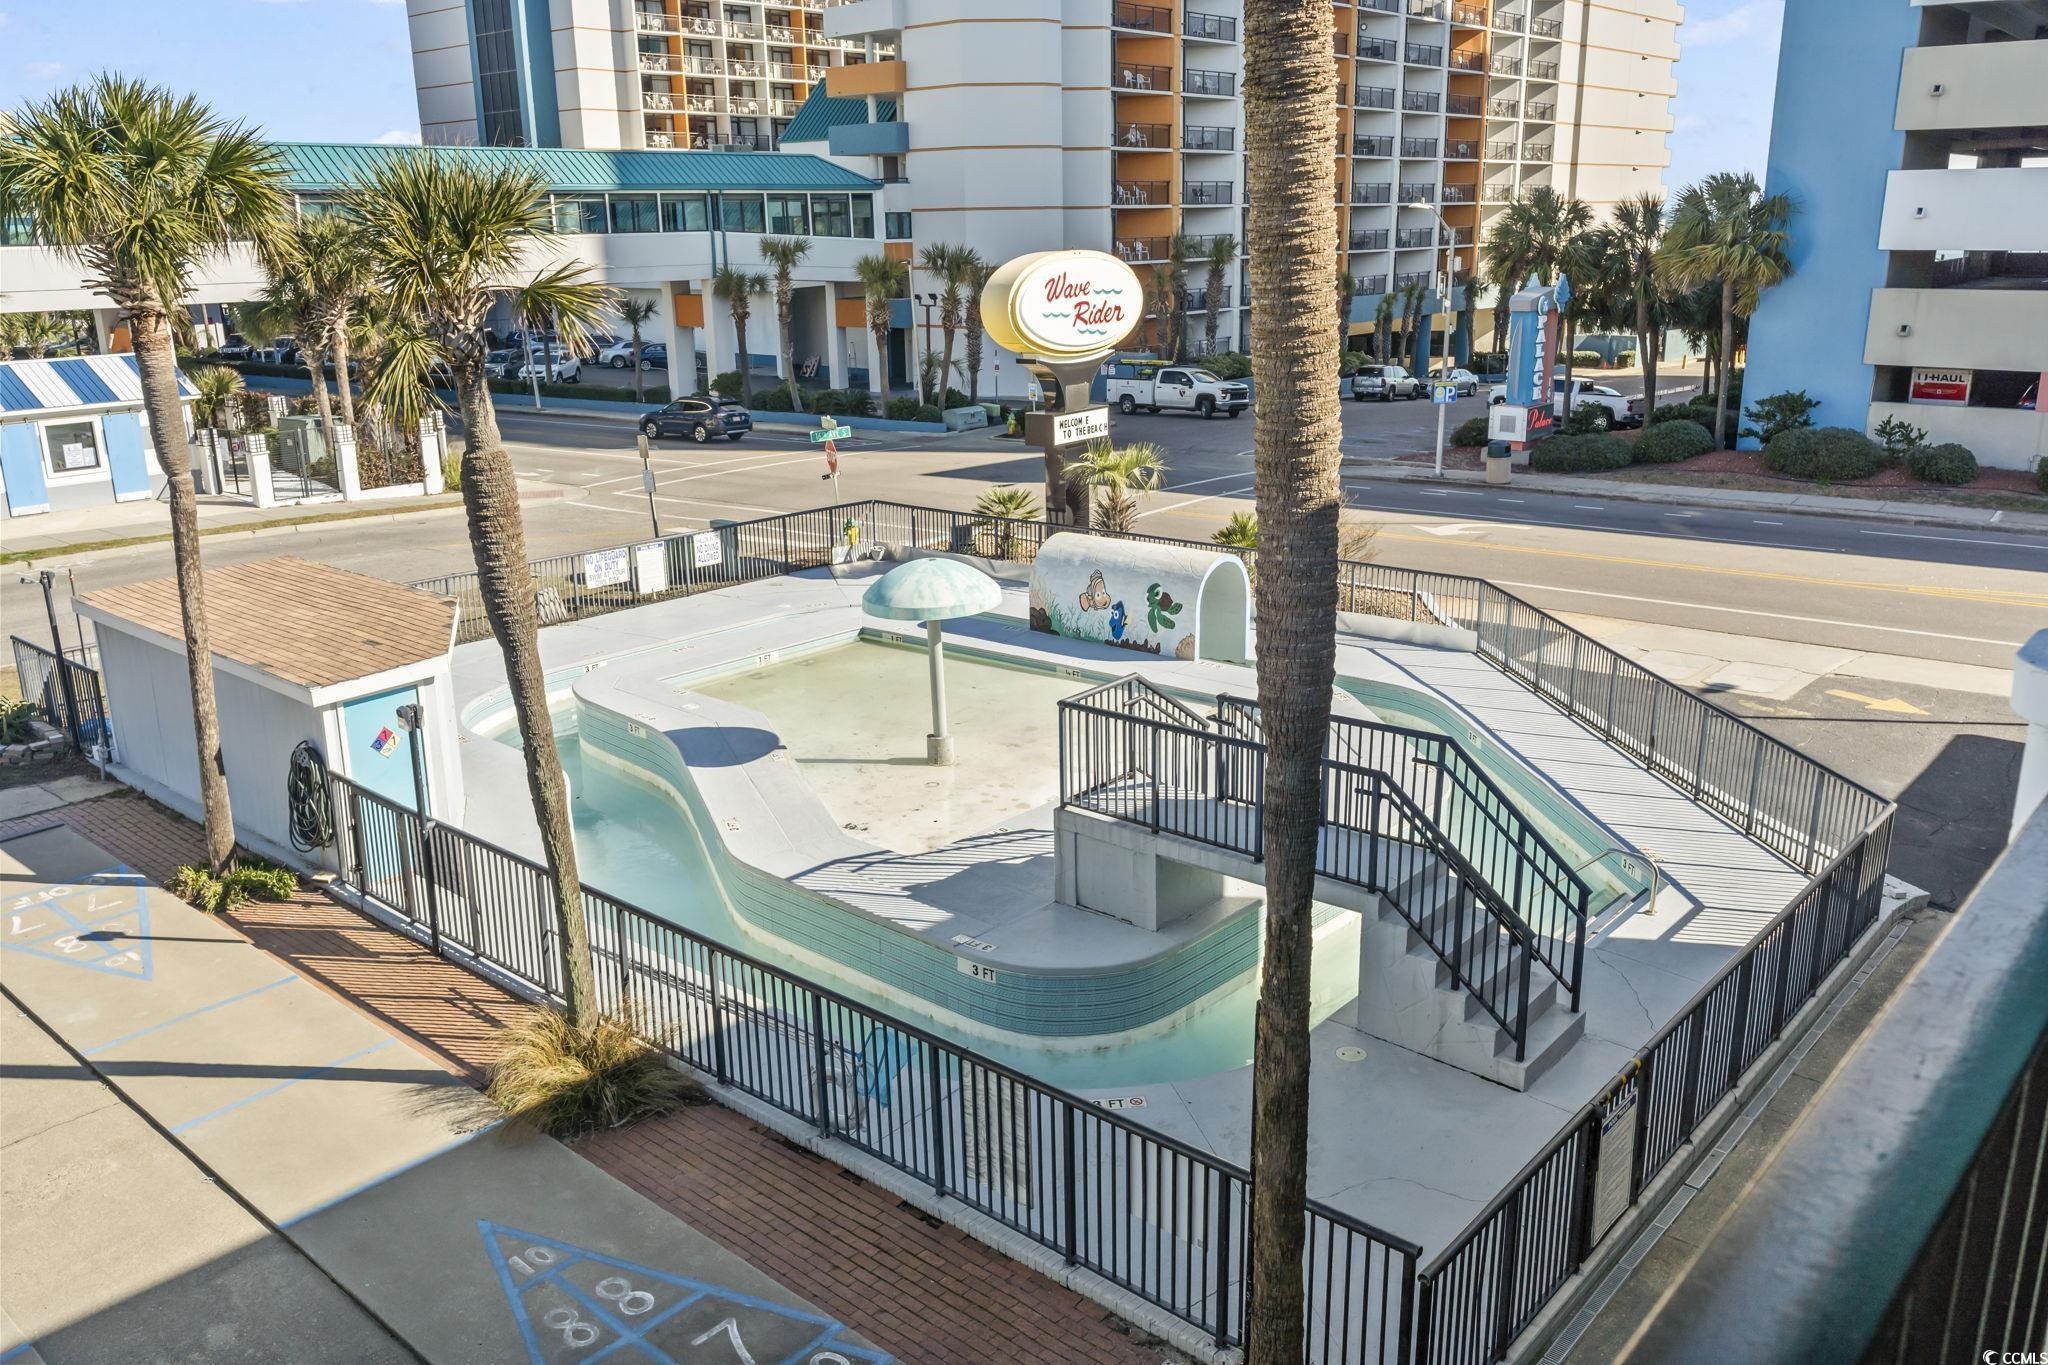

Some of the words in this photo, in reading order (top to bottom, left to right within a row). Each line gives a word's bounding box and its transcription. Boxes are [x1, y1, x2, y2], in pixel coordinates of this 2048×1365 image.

[1044, 271, 1090, 303] Wave
[1072, 299, 1124, 328] Rider
[1532, 315, 1548, 400] PALACE
[1446, 386, 1456, 402] P
[1063, 430, 1071, 439] TO
[1076, 427, 1086, 436] THE
[1087, 422, 1108, 434] BEACH
[586, 556, 593, 565] NO
[596, 550, 627, 563] LIFEGUARD
[698, 551, 719, 563] ALLOWED
[594, 564, 602, 573] ON
[605, 560, 619, 570] DUTY
[634, 726, 640, 735] FT
[375, 740, 382, 749] 3
[1623, 859, 1626, 868] 3
[1628, 863, 1634, 875] FT
[972, 964, 979, 976] 3
[983, 968, 994, 981] FT
[1108, 1099, 1124, 1108] FT
[508, 1246, 554, 1275] 10
[596, 1276, 655, 1316] 8
[543, 1307, 599, 1348] 8
[690, 1317, 756, 1365] 7
